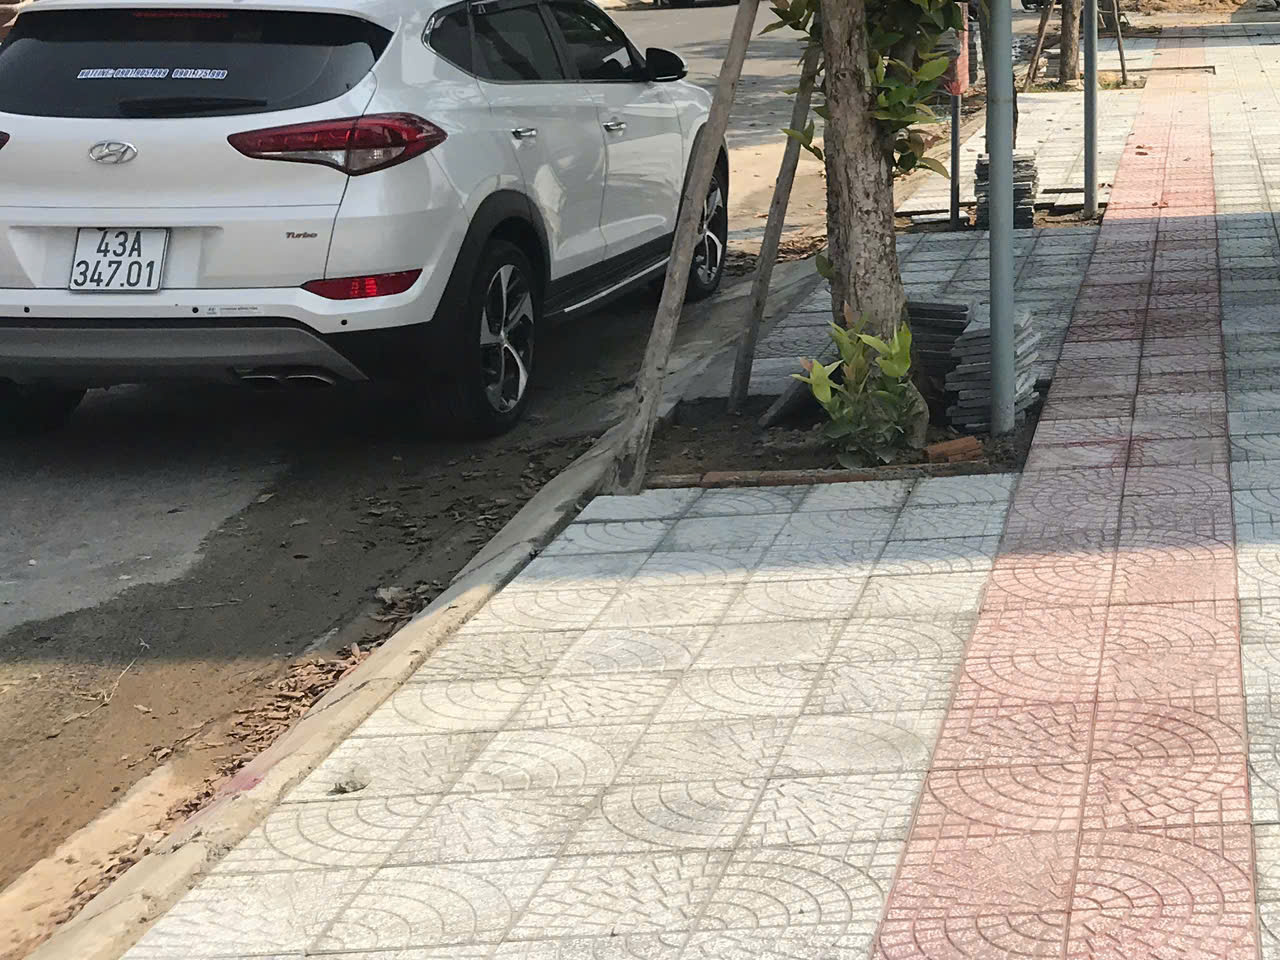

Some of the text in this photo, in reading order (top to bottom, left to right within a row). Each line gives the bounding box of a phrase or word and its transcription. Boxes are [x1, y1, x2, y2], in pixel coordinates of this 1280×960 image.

[96, 230, 143, 258] 43A
[285, 231, 318, 240] Turbo
[73, 260, 156, 288] 347.01
